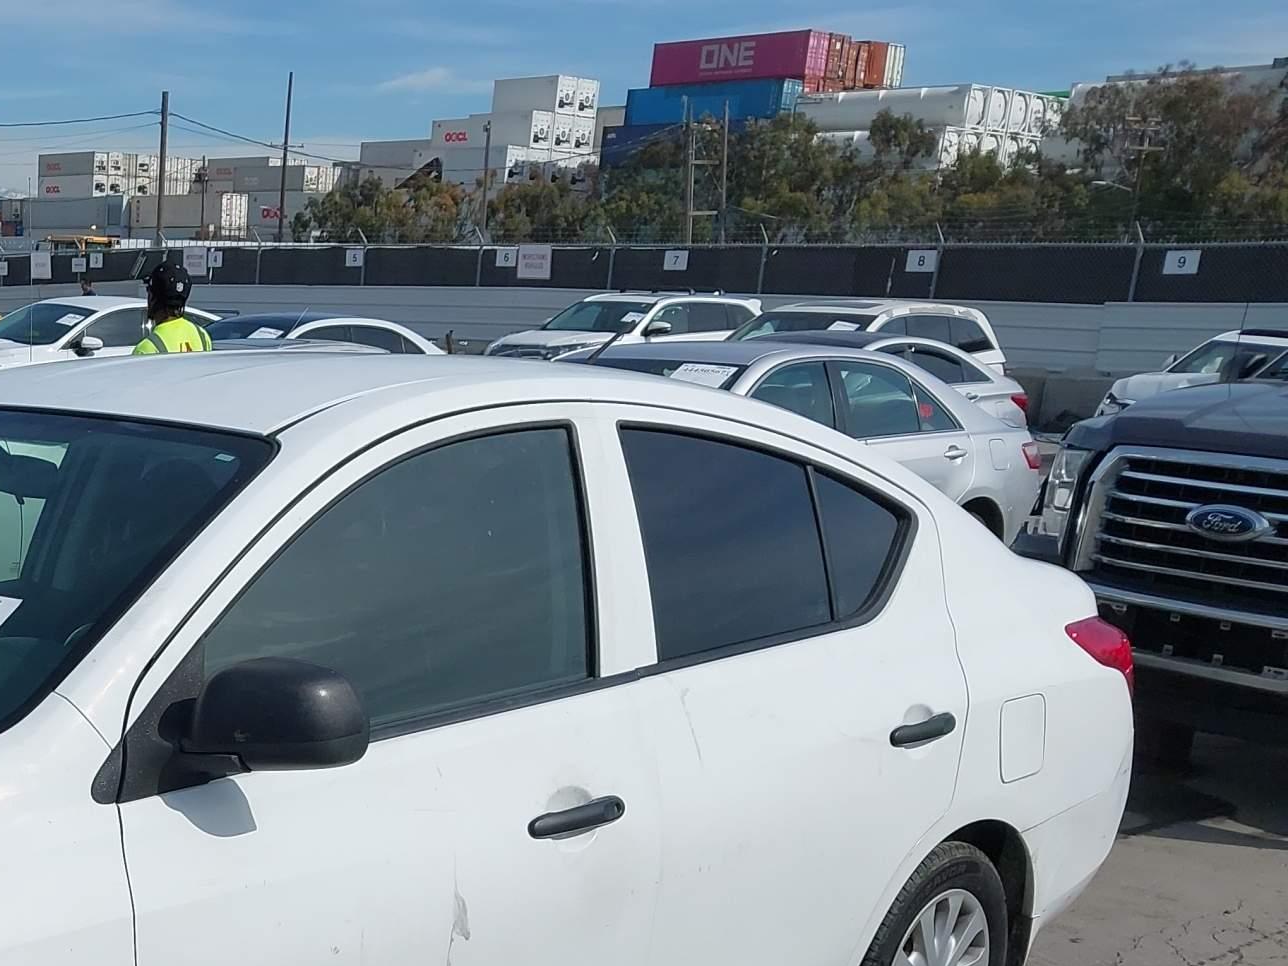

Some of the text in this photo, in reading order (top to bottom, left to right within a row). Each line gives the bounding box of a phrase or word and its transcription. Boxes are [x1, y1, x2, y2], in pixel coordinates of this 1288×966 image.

[699, 41, 756, 69] ONE
[445, 131, 468, 142] OOCL
[673, 255, 680, 265] 7
[918, 255, 926, 267] 8
[1177, 255, 1187, 269] 9
[1203, 512, 1243, 532] Ford
